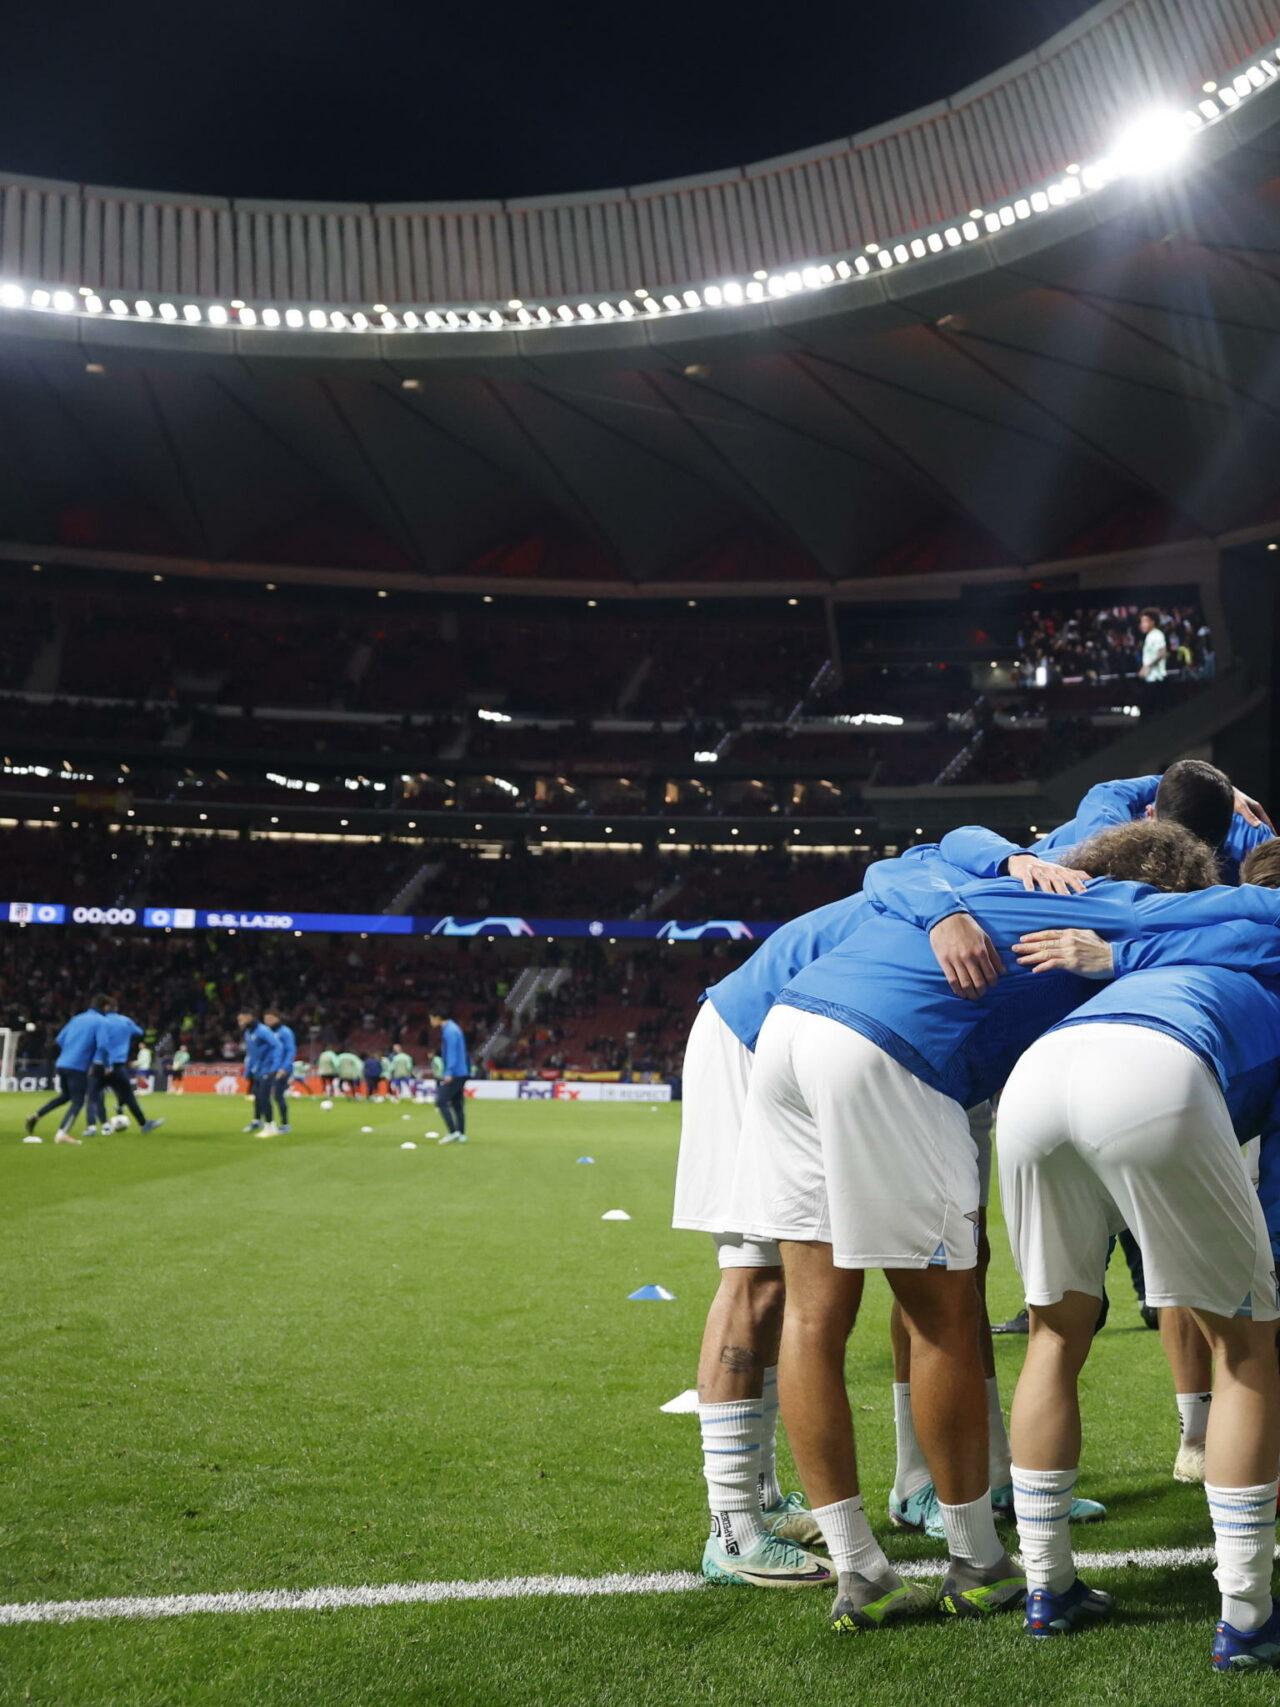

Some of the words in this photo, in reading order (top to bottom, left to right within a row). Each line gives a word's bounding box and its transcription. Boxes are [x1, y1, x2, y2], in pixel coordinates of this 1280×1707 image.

[37, 906, 57, 922] 0
[72, 906, 136, 925] 00:00
[151, 909, 170, 927] 0
[240, 914, 293, 929] LAZIO
[518, 1080, 581, 1101] FedEx
